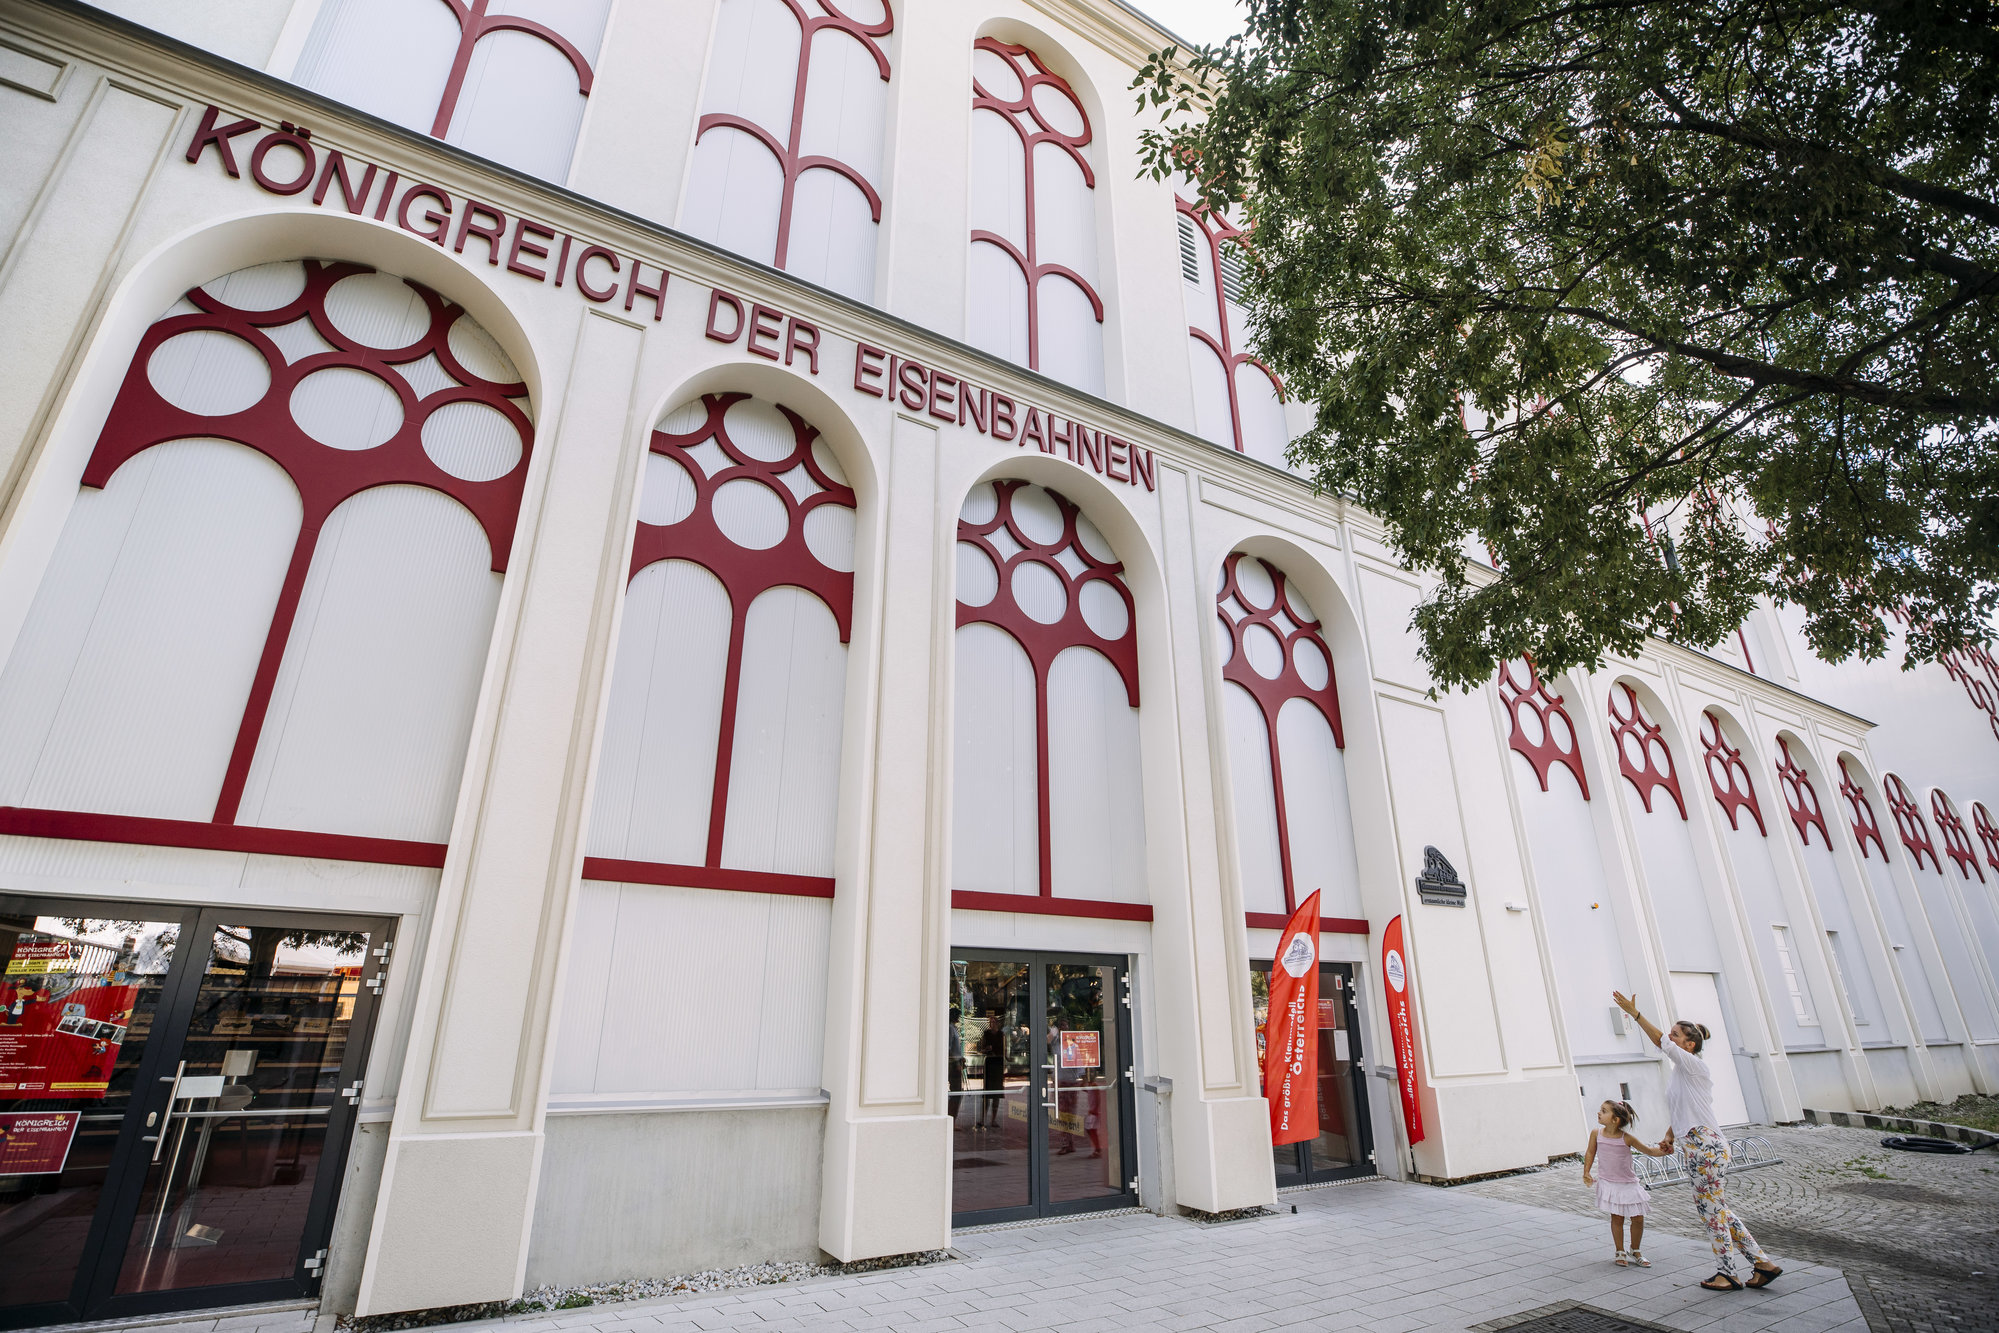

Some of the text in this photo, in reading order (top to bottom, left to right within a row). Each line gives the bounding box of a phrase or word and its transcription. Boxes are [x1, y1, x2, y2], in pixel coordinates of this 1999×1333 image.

[185, 105, 1155, 492] KÖNIGREICH DER EISENBAHNEN
[15, 1119, 70, 1127] KÖNIGREICH
[1281, 1111, 1289, 1130] Das
